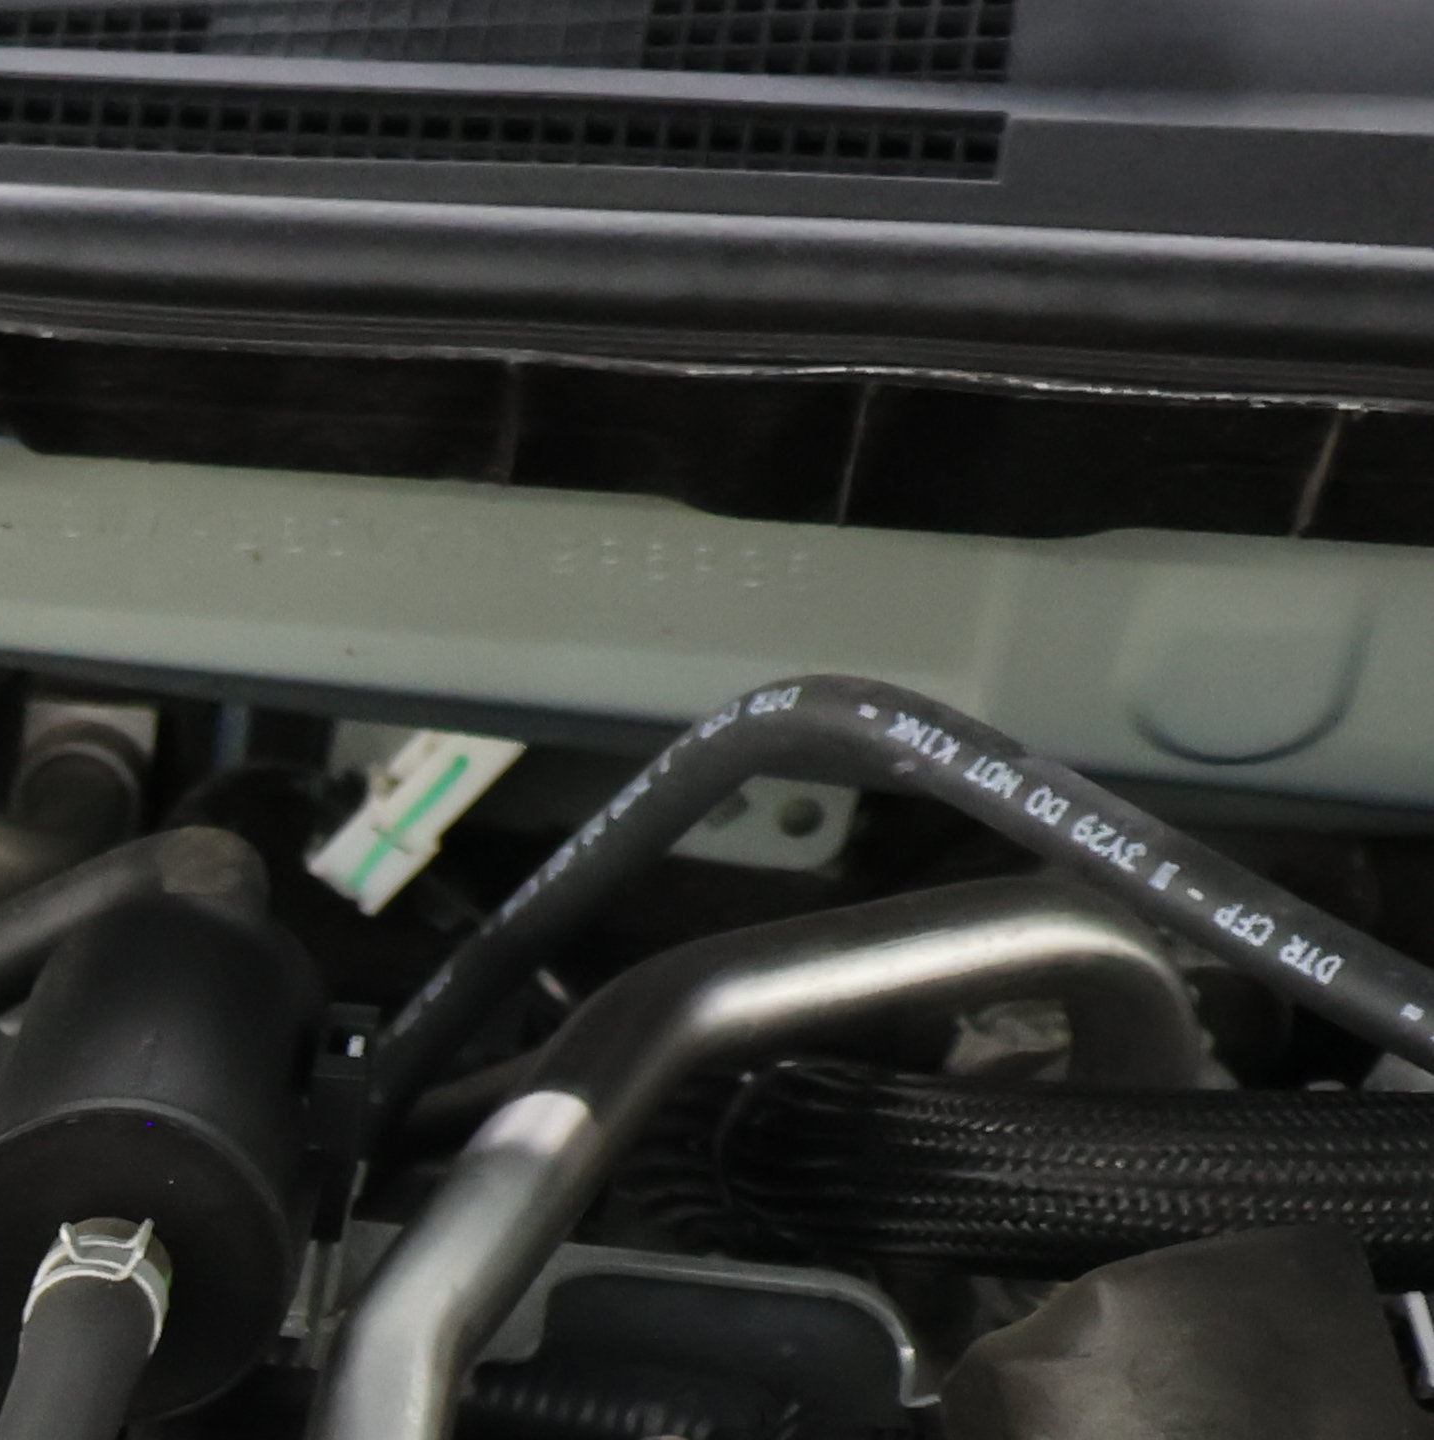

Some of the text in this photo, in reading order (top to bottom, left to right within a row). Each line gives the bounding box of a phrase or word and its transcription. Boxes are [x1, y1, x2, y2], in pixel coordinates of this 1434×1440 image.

[962, 749, 1024, 803] NOT
[1022, 782, 1072, 830] DO
[1069, 809, 1149, 875] 3Y29
[1212, 894, 1278, 951] CFP
[1276, 929, 1345, 989] DTR
